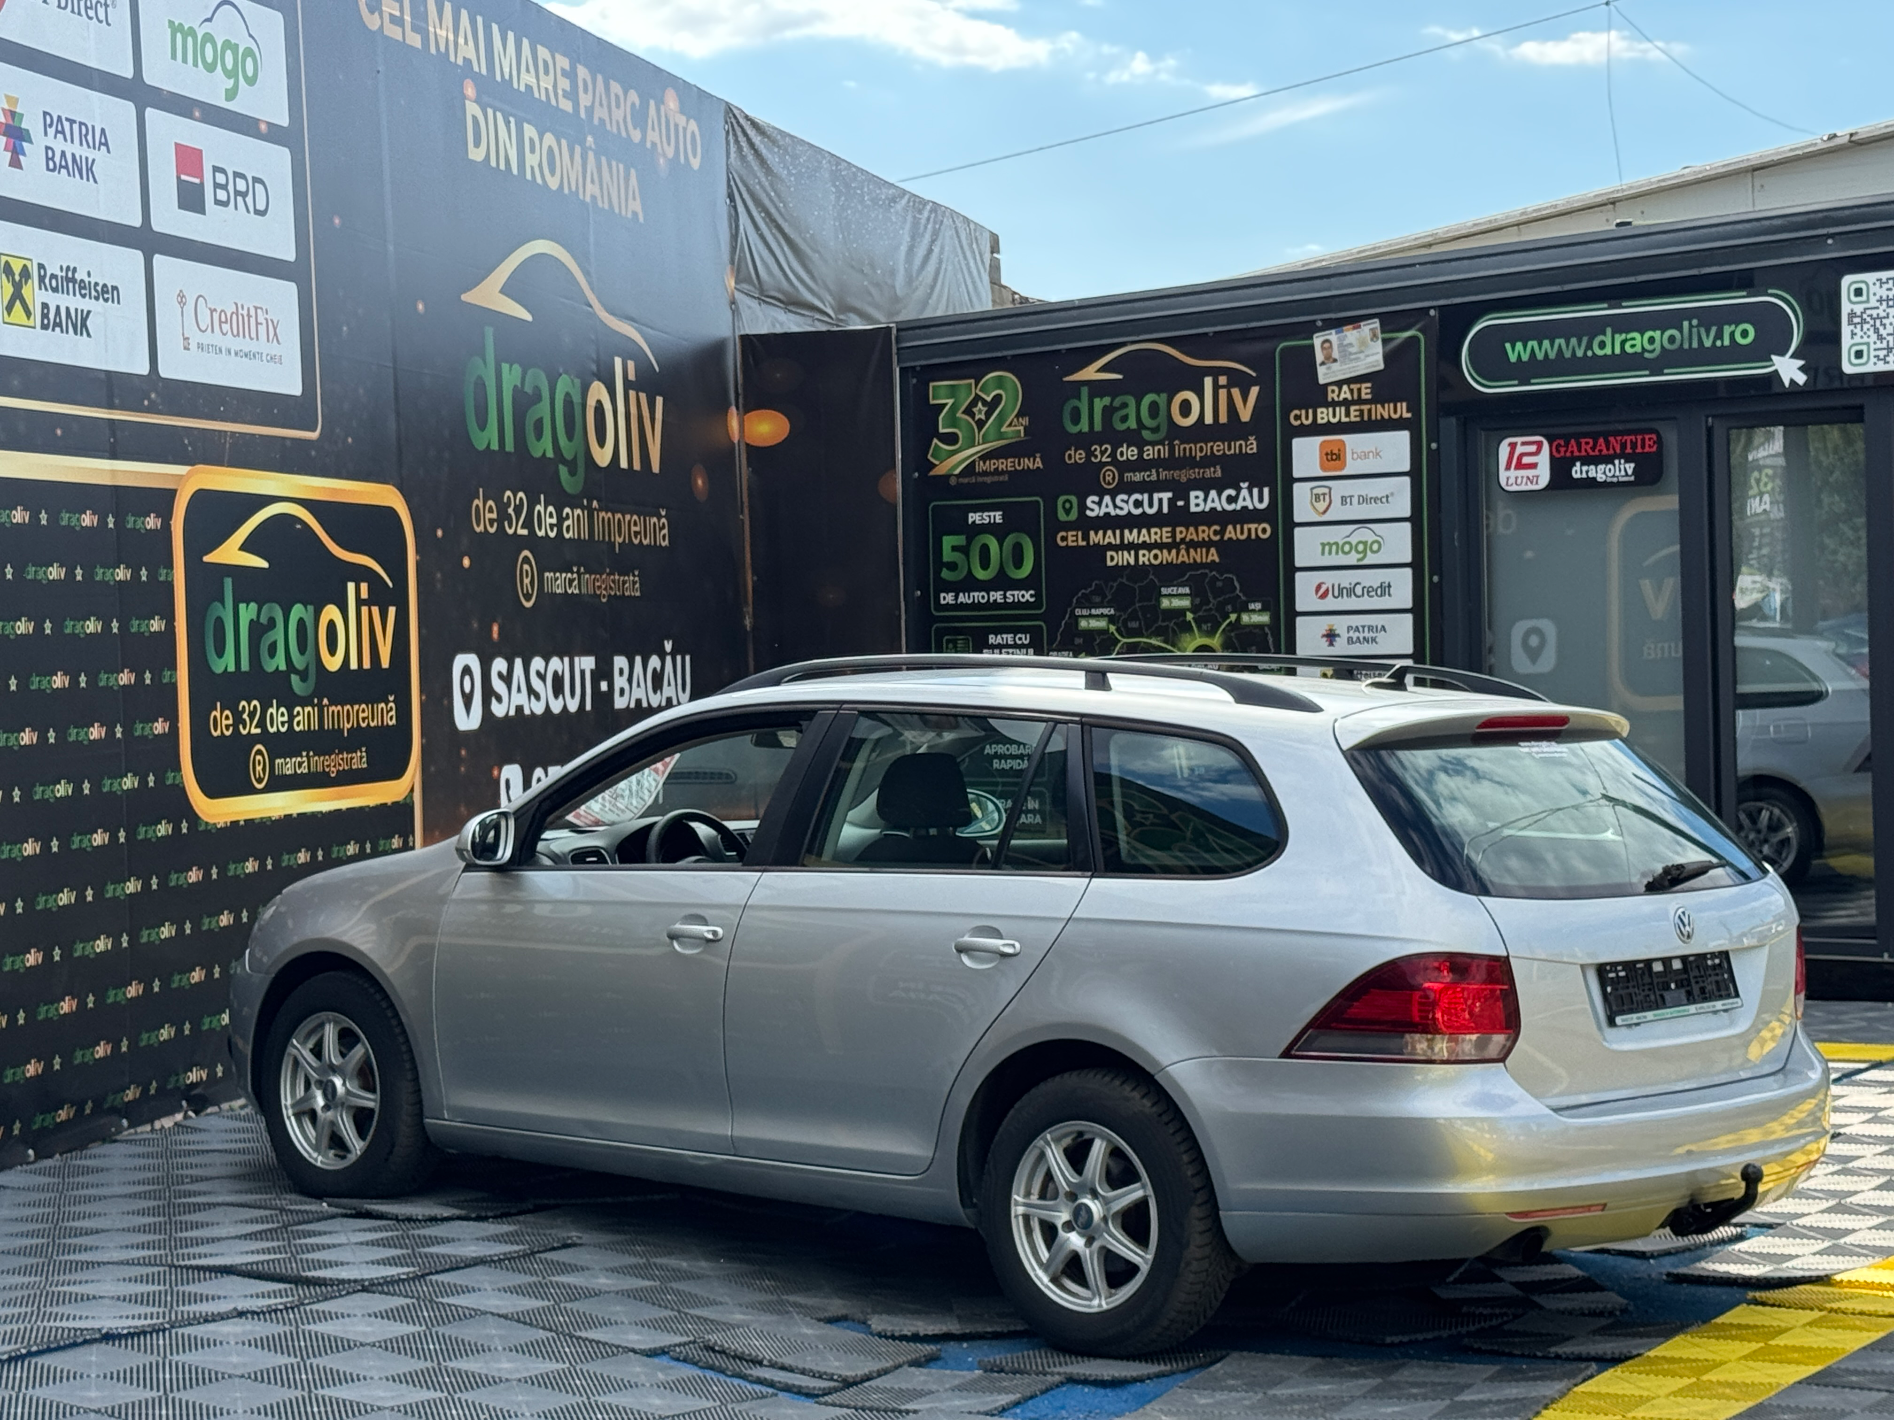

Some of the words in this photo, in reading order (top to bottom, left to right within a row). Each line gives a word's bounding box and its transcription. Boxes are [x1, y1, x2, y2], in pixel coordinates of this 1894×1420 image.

[168, 19, 260, 103] mogo
[427, 0, 487, 77] MAI
[491, 22, 573, 114] MARE
[576, 63, 642, 145] PARC
[646, 98, 702, 171] AUTO
[42, 110, 111, 154] PATRIA
[45, 146, 99, 184] BANK
[464, 99, 519, 176] DIN
[523, 121, 645, 224] ROMÂNIA
[211, 164, 271, 218] BRD
[37, 262, 122, 305] Raiffeisen
[40, 302, 93, 339] BANK
[193, 294, 282, 346] CreditFix
[196, 341, 223, 356] PRIETEN
[224, 346, 232, 357] IN
[233, 348, 264, 363] MOMENTE
[1504, 318, 1756, 365] www.dragoliv.ro
[1327, 383, 1373, 402] RATE
[463, 326, 664, 495] dragoliv
[927, 370, 1023, 465] 32
[1011, 416, 1030, 427] ANI
[1062, 375, 1260, 442] dragoliv
[1289, 408, 1314, 427] CU
[1316, 402, 1412, 424] BULETINUL
[1065, 446, 1086, 464] de
[1090, 444, 1112, 463] 32
[1116, 442, 1138, 461] de
[1143, 440, 1169, 460] ani
[1173, 435, 1258, 461] împreună
[1324, 449, 1342, 463] tbi
[1351, 447, 1383, 461] bank
[1504, 440, 1544, 472] 12
[1551, 433, 1659, 458] GARANTIE
[975, 453, 1044, 473] ÎMPREUNĂ
[1123, 468, 1157, 483] marcă
[1158, 465, 1222, 483] înregistrată
[1571, 458, 1636, 482] dragoliv
[1505, 474, 1541, 487] LUNI
[1085, 491, 1173, 518] SASCUT
[1189, 482, 1270, 513] BACĂU
[1314, 492, 1328, 504] BT
[1340, 494, 1355, 507] BT
[58, 510, 99, 532] dragoliv
[125, 512, 162, 534] dragoliv
[471, 487, 498, 534] de
[503, 489, 529, 536] 32
[534, 494, 558, 538] de
[562, 498, 589, 540] ani
[592, 500, 670, 553] împreună
[968, 511, 1003, 525] PESTE
[1056, 531, 1087, 547] CEL
[1089, 529, 1121, 546] MAI
[1123, 527, 1173, 545] MARE
[1175, 525, 1221, 542] PARC
[1223, 523, 1272, 540] AUTO
[1319, 538, 1383, 563] mogo
[940, 531, 1035, 582] 500
[1106, 551, 1136, 566] DIN
[1138, 545, 1220, 566] ROMÂNIA
[25, 562, 67, 584] dragoliv
[94, 563, 132, 585] dragoliv
[543, 565, 580, 595] marcă
[580, 566, 642, 603] înregistrată
[940, 592, 956, 605] DE
[957, 591, 988, 605] AUTO
[990, 591, 1004, 604] PE
[1006, 590, 1036, 603] STOC
[1331, 581, 1393, 600] UniCredit
[63, 616, 103, 638] dragoliv
[129, 615, 166, 637] dragoliv
[204, 576, 397, 697] dragoliv
[988, 633, 1014, 646] RATE
[1015, 633, 1031, 645] CU
[1346, 624, 1388, 635] PATRIA
[1346, 635, 1379, 646] BANK
[29, 670, 70, 693] dragoliv
[98, 668, 136, 690] dragoliv
[490, 655, 596, 718] SASCUT
[599, 680, 609, 692] -
[613, 639, 692, 710] BACĂU
[66, 721, 107, 745] dragoliv
[133, 716, 170, 739] dragoliv
[209, 701, 233, 737] de
[238, 699, 262, 735] 32
[266, 698, 289, 734] de
[293, 697, 319, 731] ani
[322, 694, 397, 737] împreună
[274, 750, 309, 776] marcă
[309, 746, 368, 778] înregistrată
[32, 778, 74, 803] dragoliv
[101, 772, 140, 795] dragoliv
[0, 837, 42, 862] dragoliv
[70, 828, 110, 851] dragoliv
[136, 818, 173, 842] dragoliv
[34, 887, 77, 912] dragoliv
[104, 876, 143, 900] dragoliv
[168, 865, 204, 888] dragoliv
[226, 856, 260, 878] dragoliv
[281, 847, 311, 869] dragoliv
[331, 839, 360, 860] dragoliv
[2, 947, 44, 973] dragoliv
[72, 933, 114, 958] dragoliv
[139, 921, 177, 945] dragoliv
[201, 909, 236, 932] dragoliv
[36, 995, 78, 1022] dragoliv
[105, 979, 145, 1005] dragoliv
[170, 965, 207, 990] dragoliv
[3, 1057, 45, 1085] dragoliv
[73, 1039, 113, 1066] dragoliv
[138, 1022, 177, 1048] dragoliv
